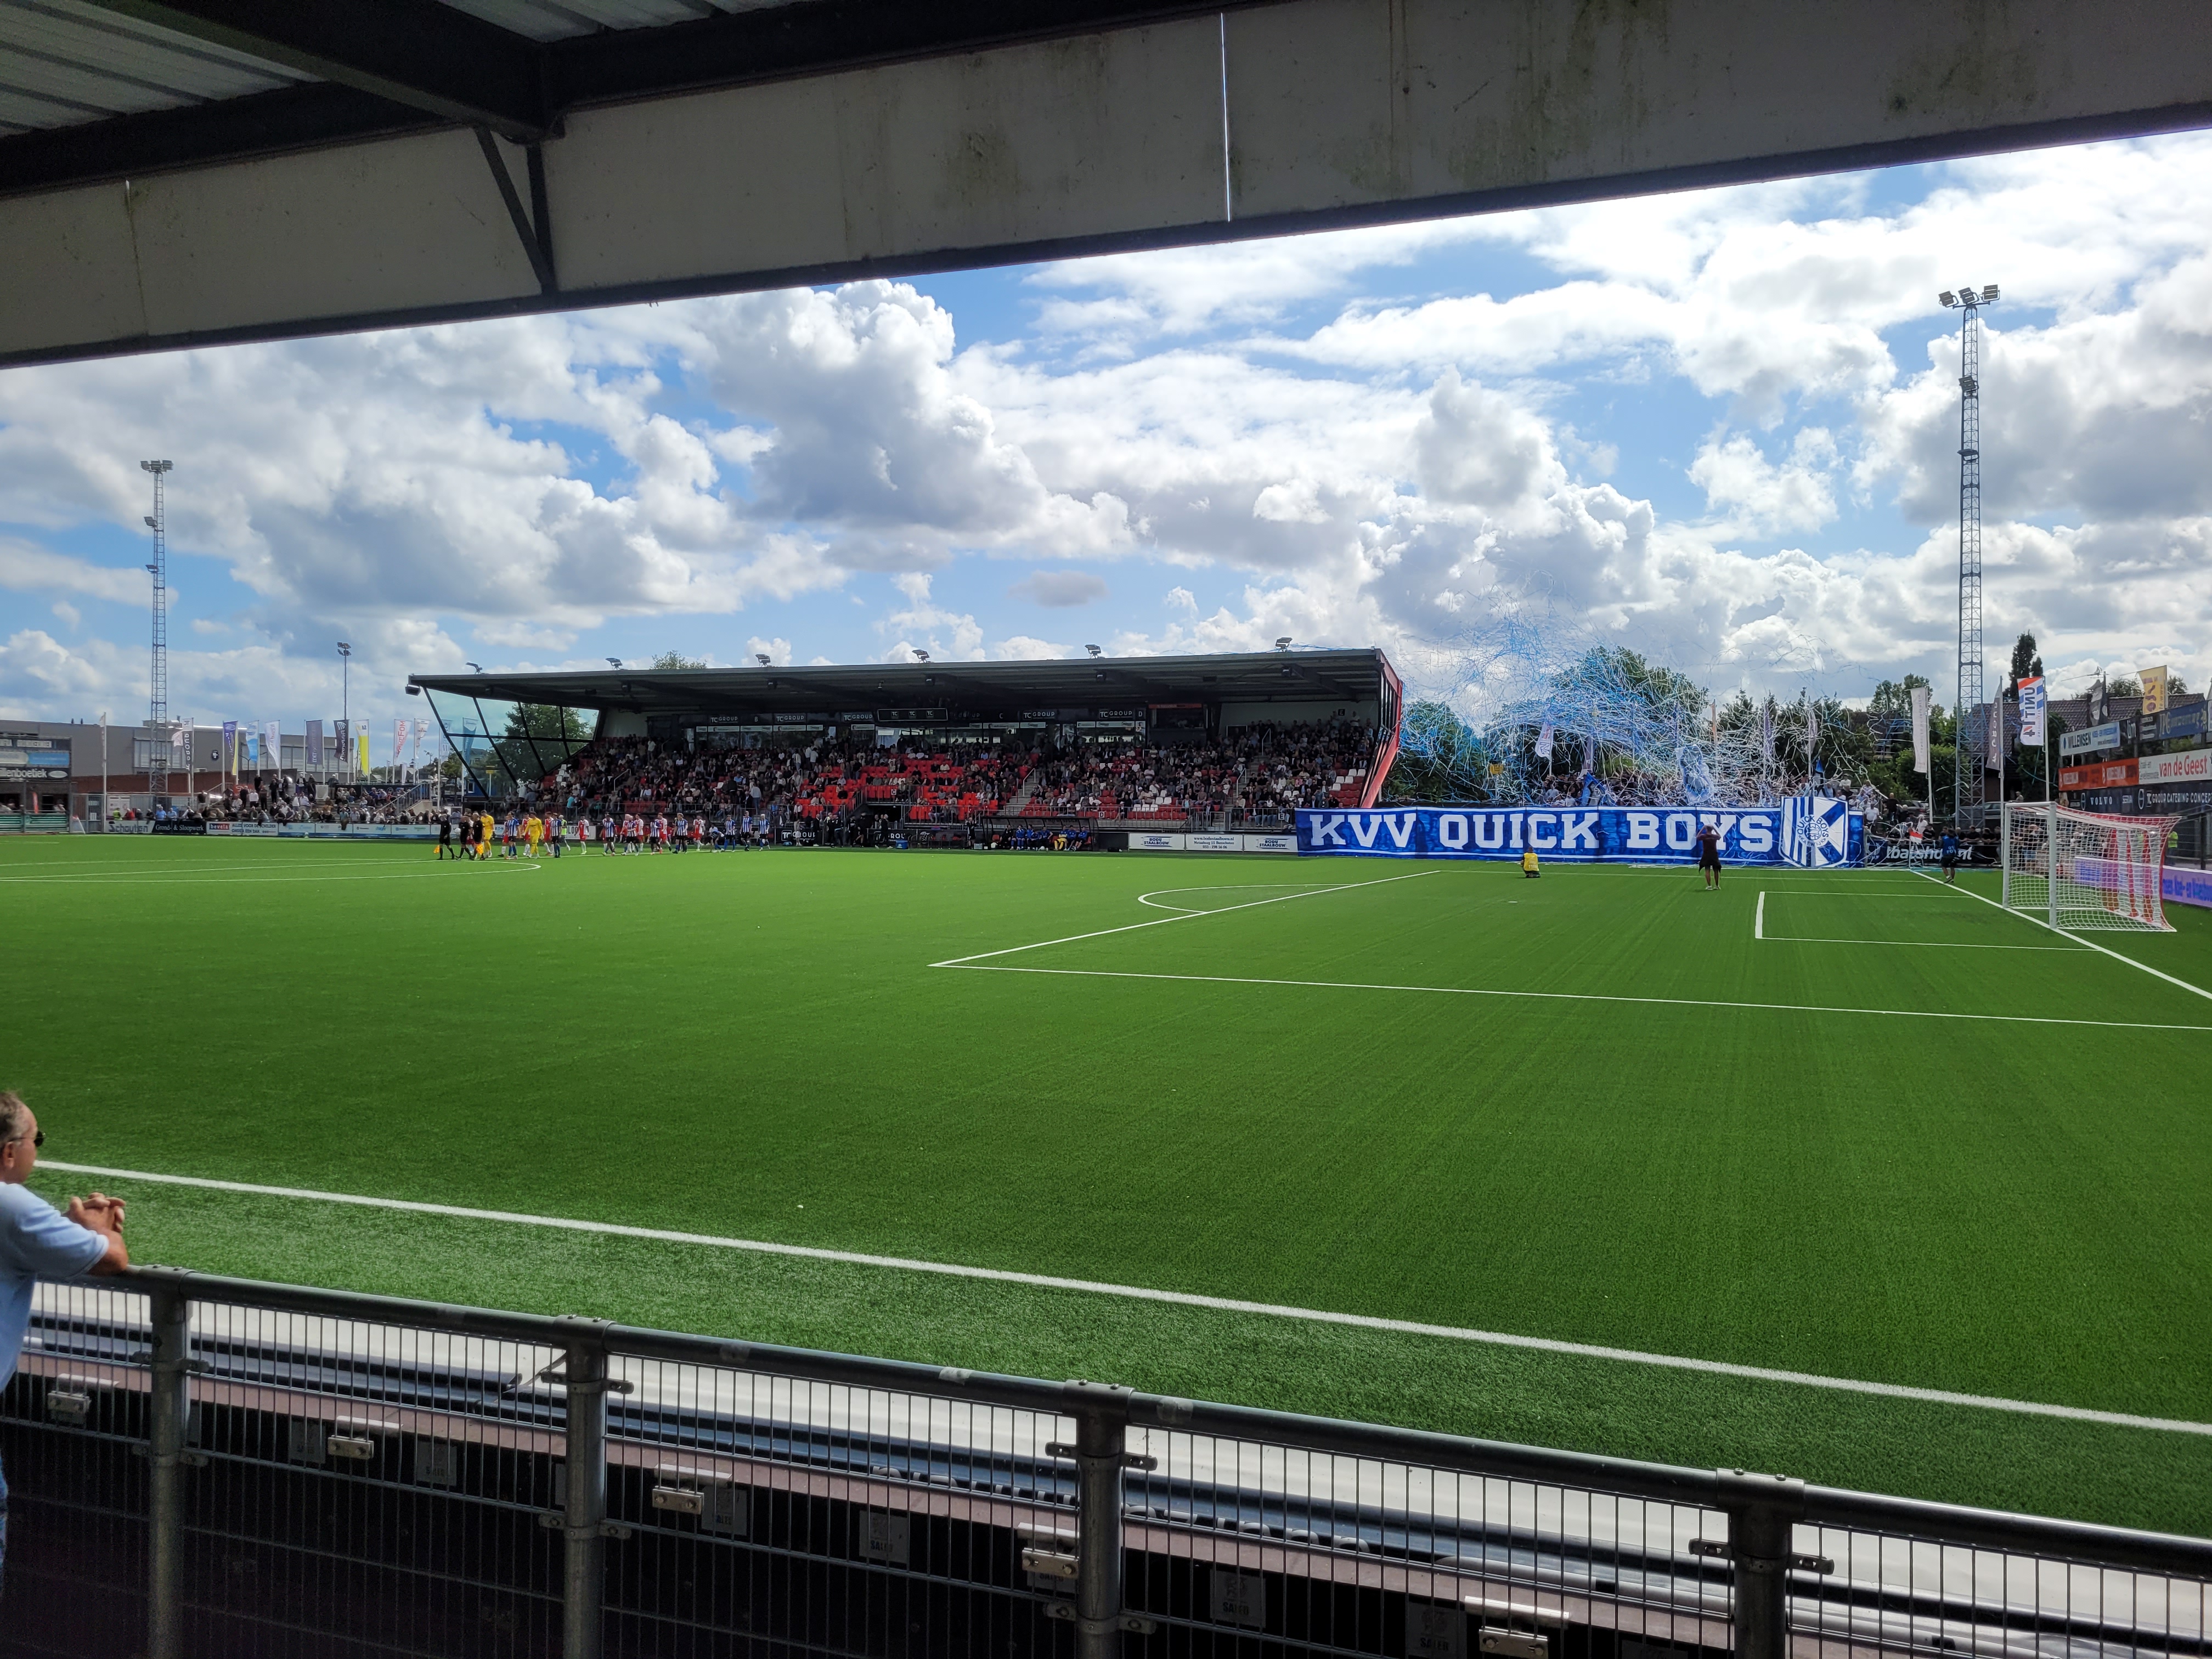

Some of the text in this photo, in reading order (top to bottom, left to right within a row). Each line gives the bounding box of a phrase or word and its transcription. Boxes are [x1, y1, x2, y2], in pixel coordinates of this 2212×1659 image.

[2159, 762, 2171, 777] van
[2173, 755, 2183, 776] de
[2184, 754, 2208, 776] Geest
[2090, 796, 2112, 805] VOLVO
[2152, 793, 2166, 803] GROUP
[2167, 793, 2189, 803] CATERING
[2190, 792, 2212, 803] CONCEP
[1309, 812, 1773, 853] KVV QUICK BOYS
[1797, 815, 1829, 838] QUICK BOYS
